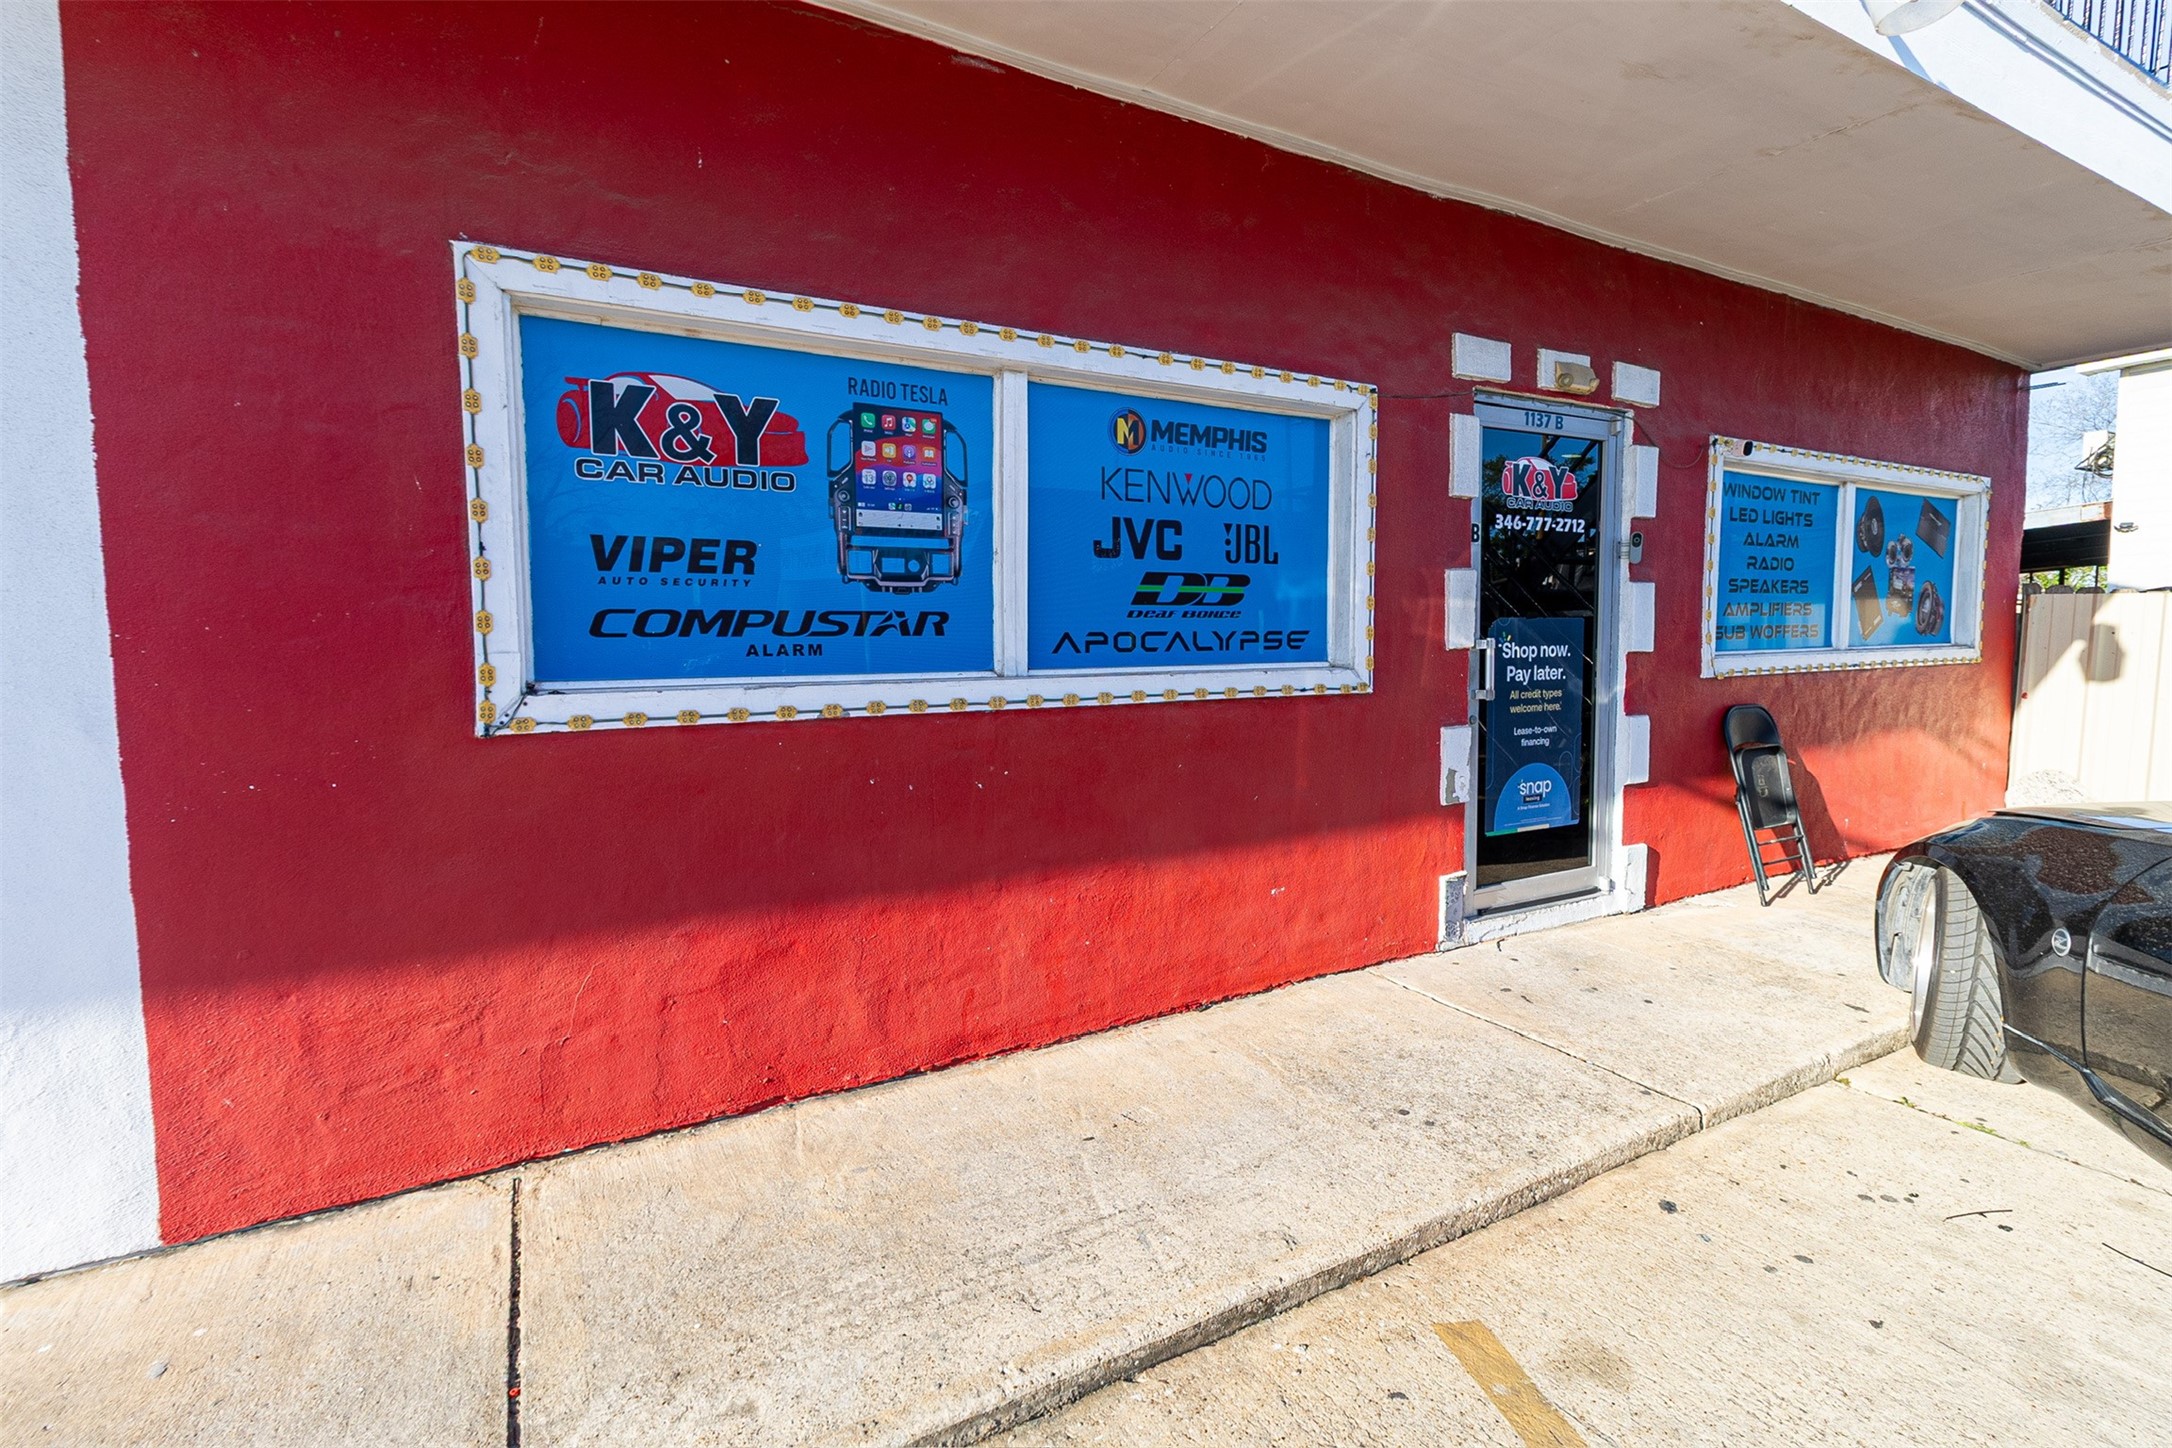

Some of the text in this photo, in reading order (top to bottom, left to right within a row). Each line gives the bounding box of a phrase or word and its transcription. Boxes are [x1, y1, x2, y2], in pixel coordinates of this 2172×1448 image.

[847, 376, 949, 406] RADIO TESLA
[589, 379, 780, 466] K&Y
[1524, 411, 1564, 430] 1137 B
[1150, 419, 1268, 454] MEMPHIS
[1151, 443, 1188, 454] AUDIO
[1197, 448, 1231, 459] SINCE
[575, 457, 797, 492] CAR AUDIO
[1512, 463, 1569, 499] K&Y
[1101, 466, 1272, 510] KENWOOD
[1723, 481, 1821, 506] WINDOW TINT
[1507, 497, 1574, 512] CAR AUDIO
[1494, 513, 1586, 533] 346-777-2712
[1729, 506, 1813, 527] LED LIGHTS
[1093, 517, 1279, 564] JVC JBL
[1743, 531, 1799, 549] ALARM
[589, 534, 758, 575] VIPER
[1747, 556, 1795, 571] RADIO
[598, 576, 752, 587] AUTO SECURITY
[1130, 571, 1251, 607] DB
[1728, 578, 1809, 594] SPEAKERS
[1723, 602, 1812, 616] AMPLIFIERS
[588, 608, 950, 638] COMPUSTAR
[1715, 624, 1819, 640] SUB WOFFERS
[746, 643, 823, 657] ALARM
[1052, 630, 1310, 654] APOCALYPSE
[1502, 642, 1571, 662] Shop now.
[1506, 664, 1566, 685] Pay later.
[1509, 688, 1563, 700] All credit types
[1509, 704, 1543, 713] welcome
[1513, 725, 1557, 736] Lease-to-own
[1521, 737, 1550, 747] financing
[1519, 780, 1552, 798] snap
